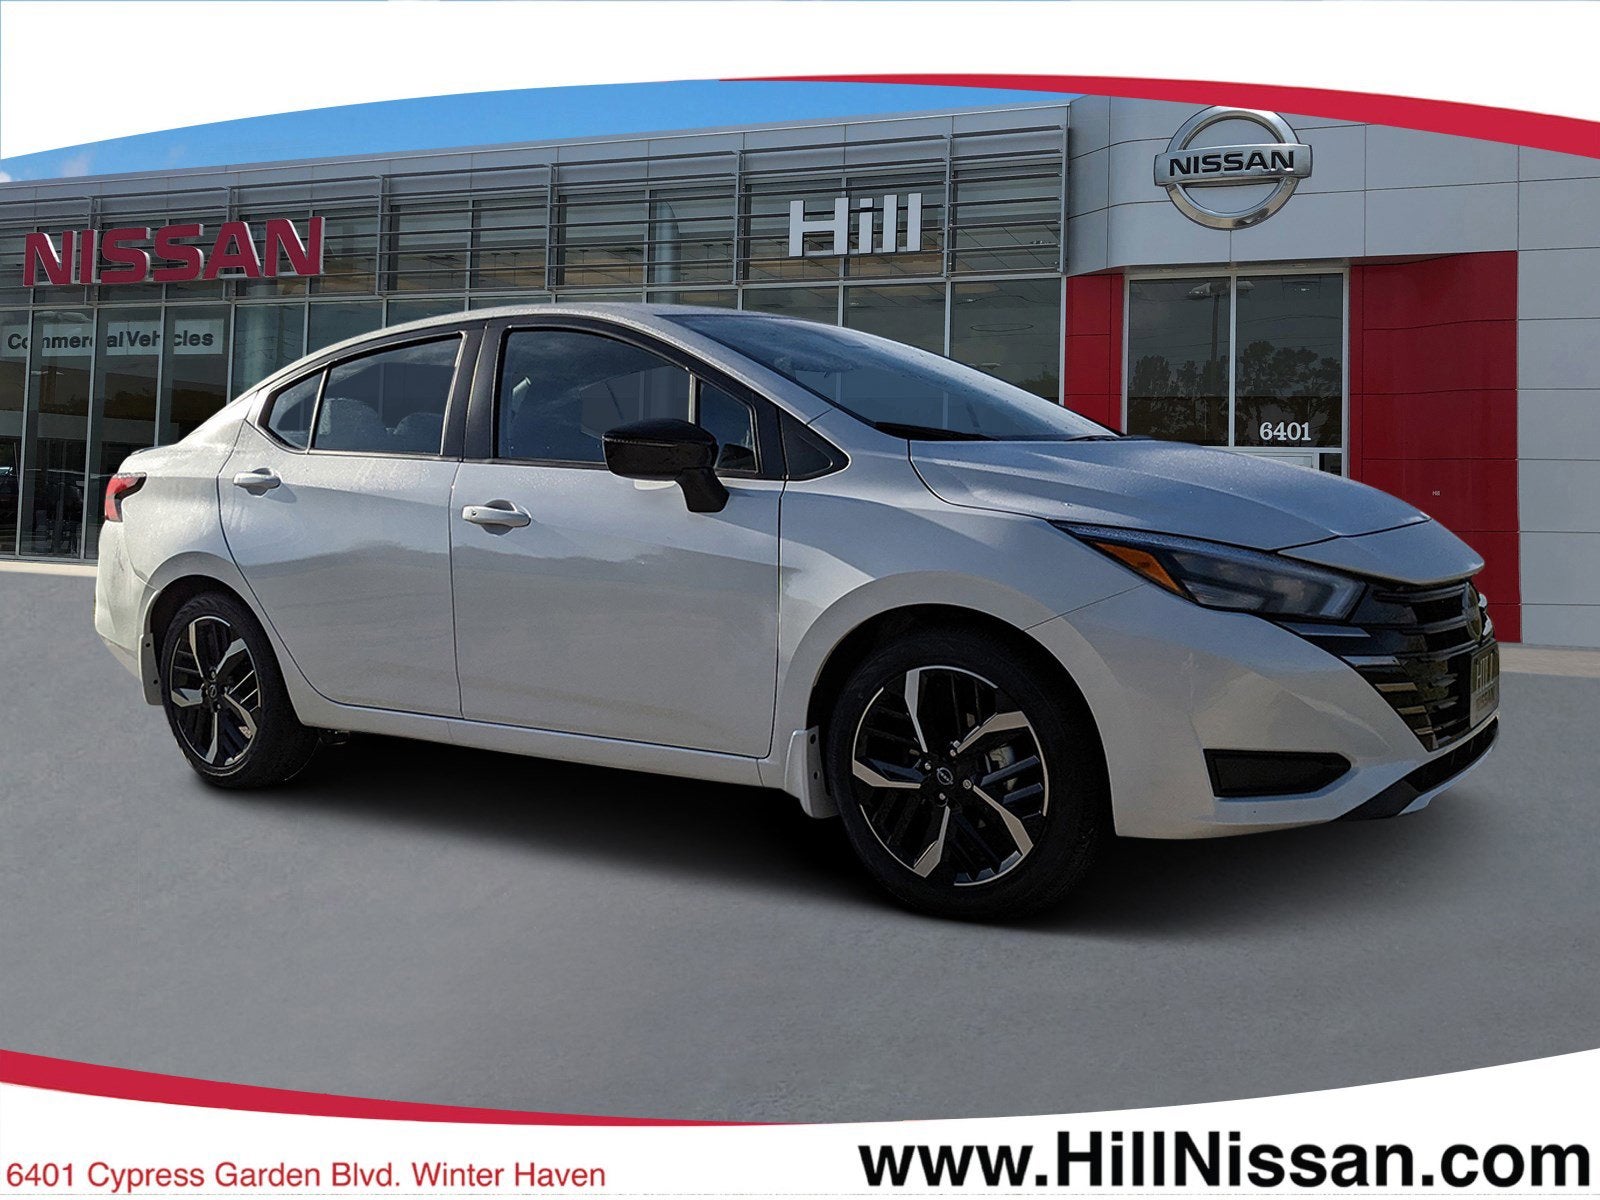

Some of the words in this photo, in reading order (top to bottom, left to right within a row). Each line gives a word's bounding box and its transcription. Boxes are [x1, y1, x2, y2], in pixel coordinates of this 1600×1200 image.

[1168, 149, 1295, 176] NISSAN
[789, 192, 922, 257] Hill
[23, 216, 325, 287] NISSAN
[7, 332, 124, 350] Cmeral
[126, 330, 214, 347] Vehcles
[1259, 421, 1312, 441] 6401
